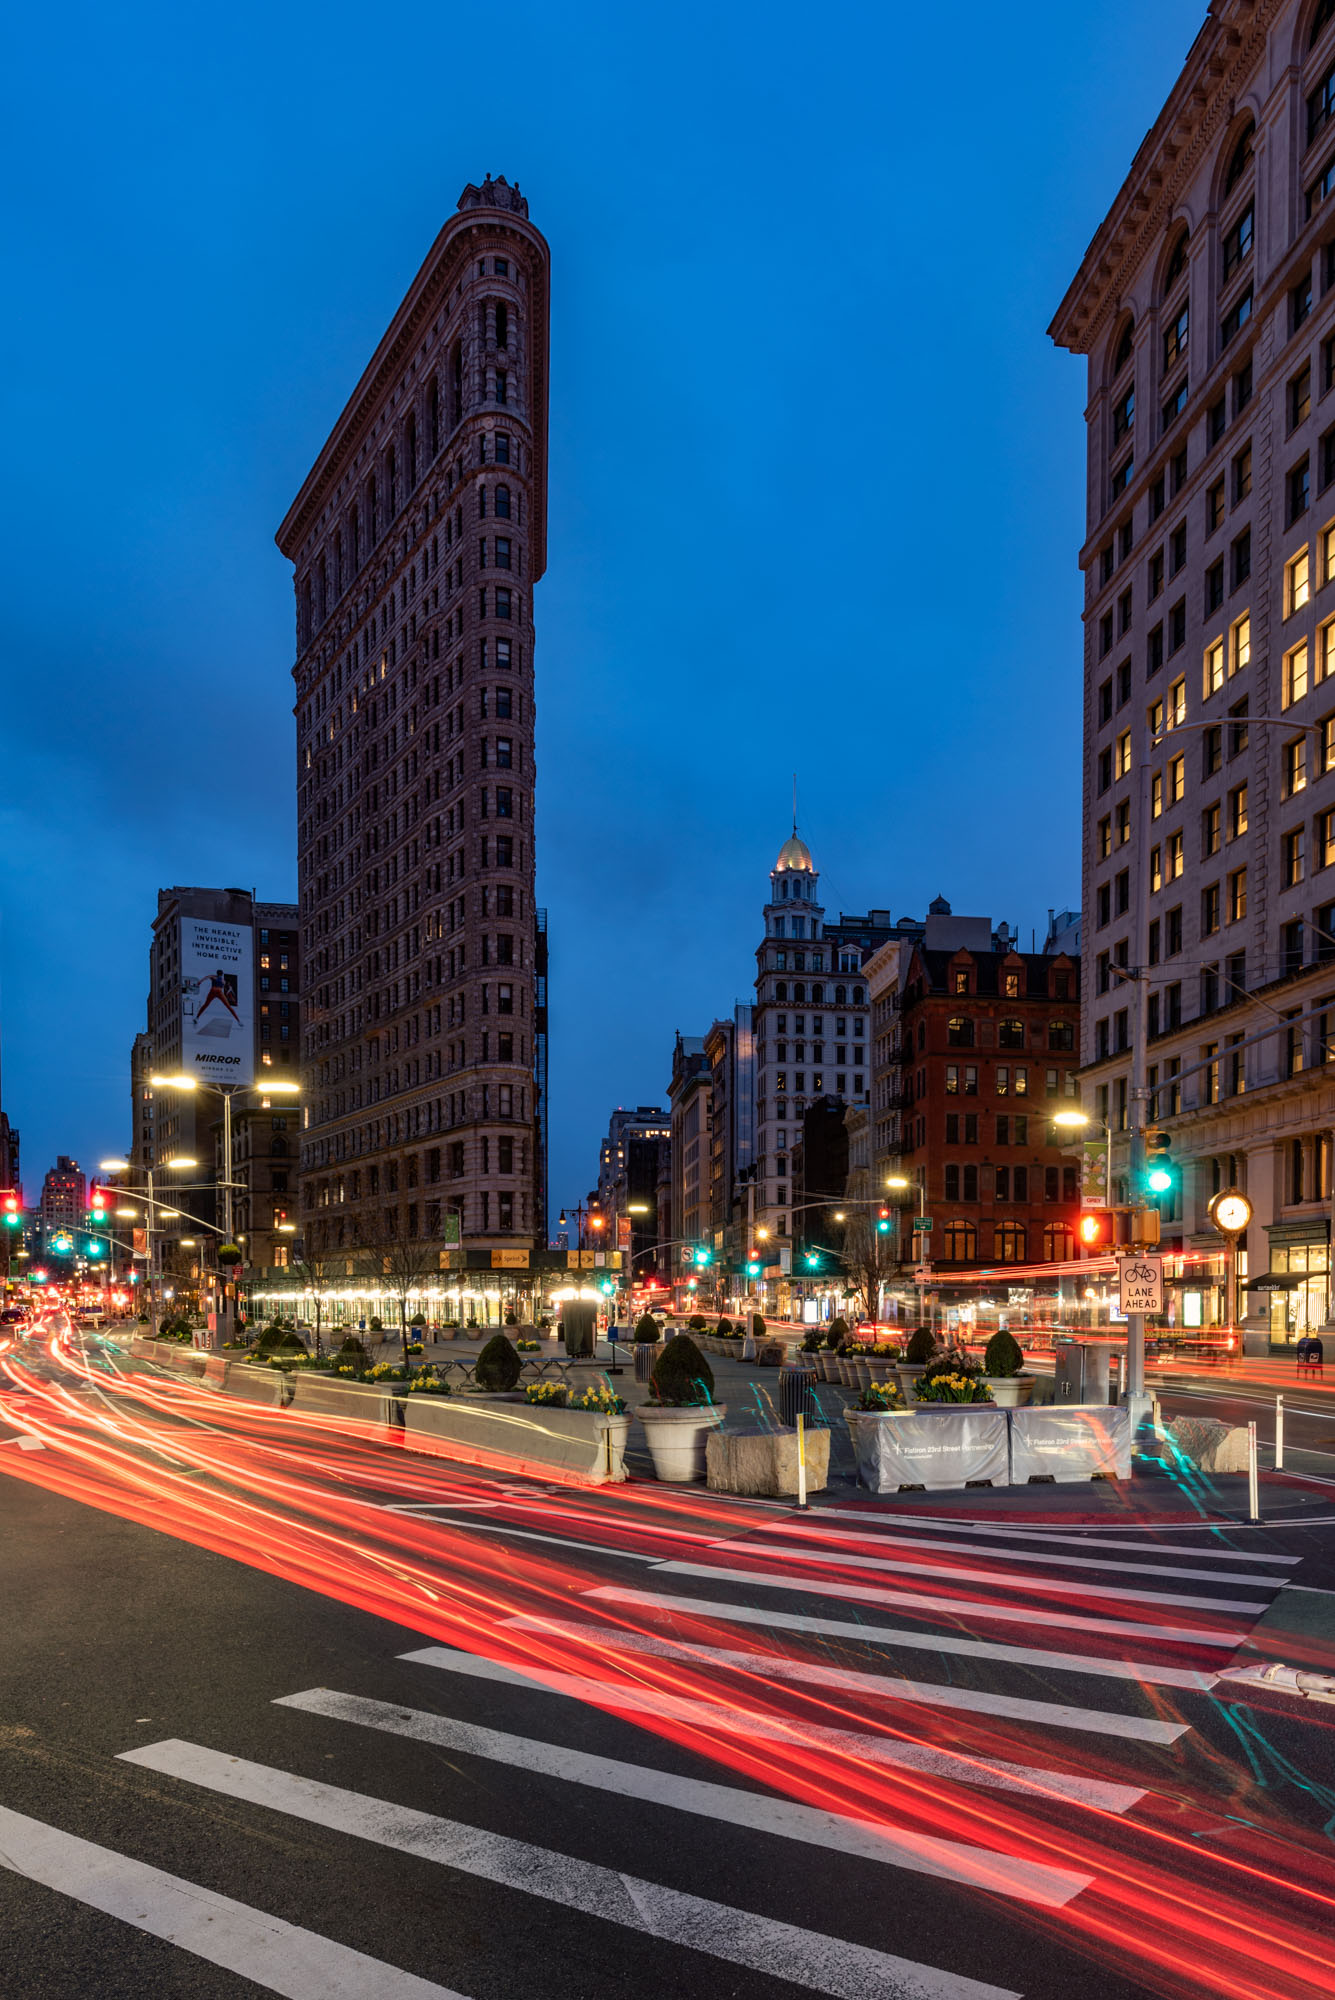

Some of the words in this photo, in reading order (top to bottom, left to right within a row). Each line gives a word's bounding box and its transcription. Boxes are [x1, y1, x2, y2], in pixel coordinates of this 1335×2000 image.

[194, 926, 208, 934] THE
[212, 929, 240, 938] NEARLY
[192, 942, 242, 954] INTERACTIVE
[195, 1053, 241, 1065] MIRROR
[503, 1255, 521, 1263] Sprint
[1128, 1288, 1153, 1296] LANE
[1125, 1299, 1157, 1308] AHEAD
